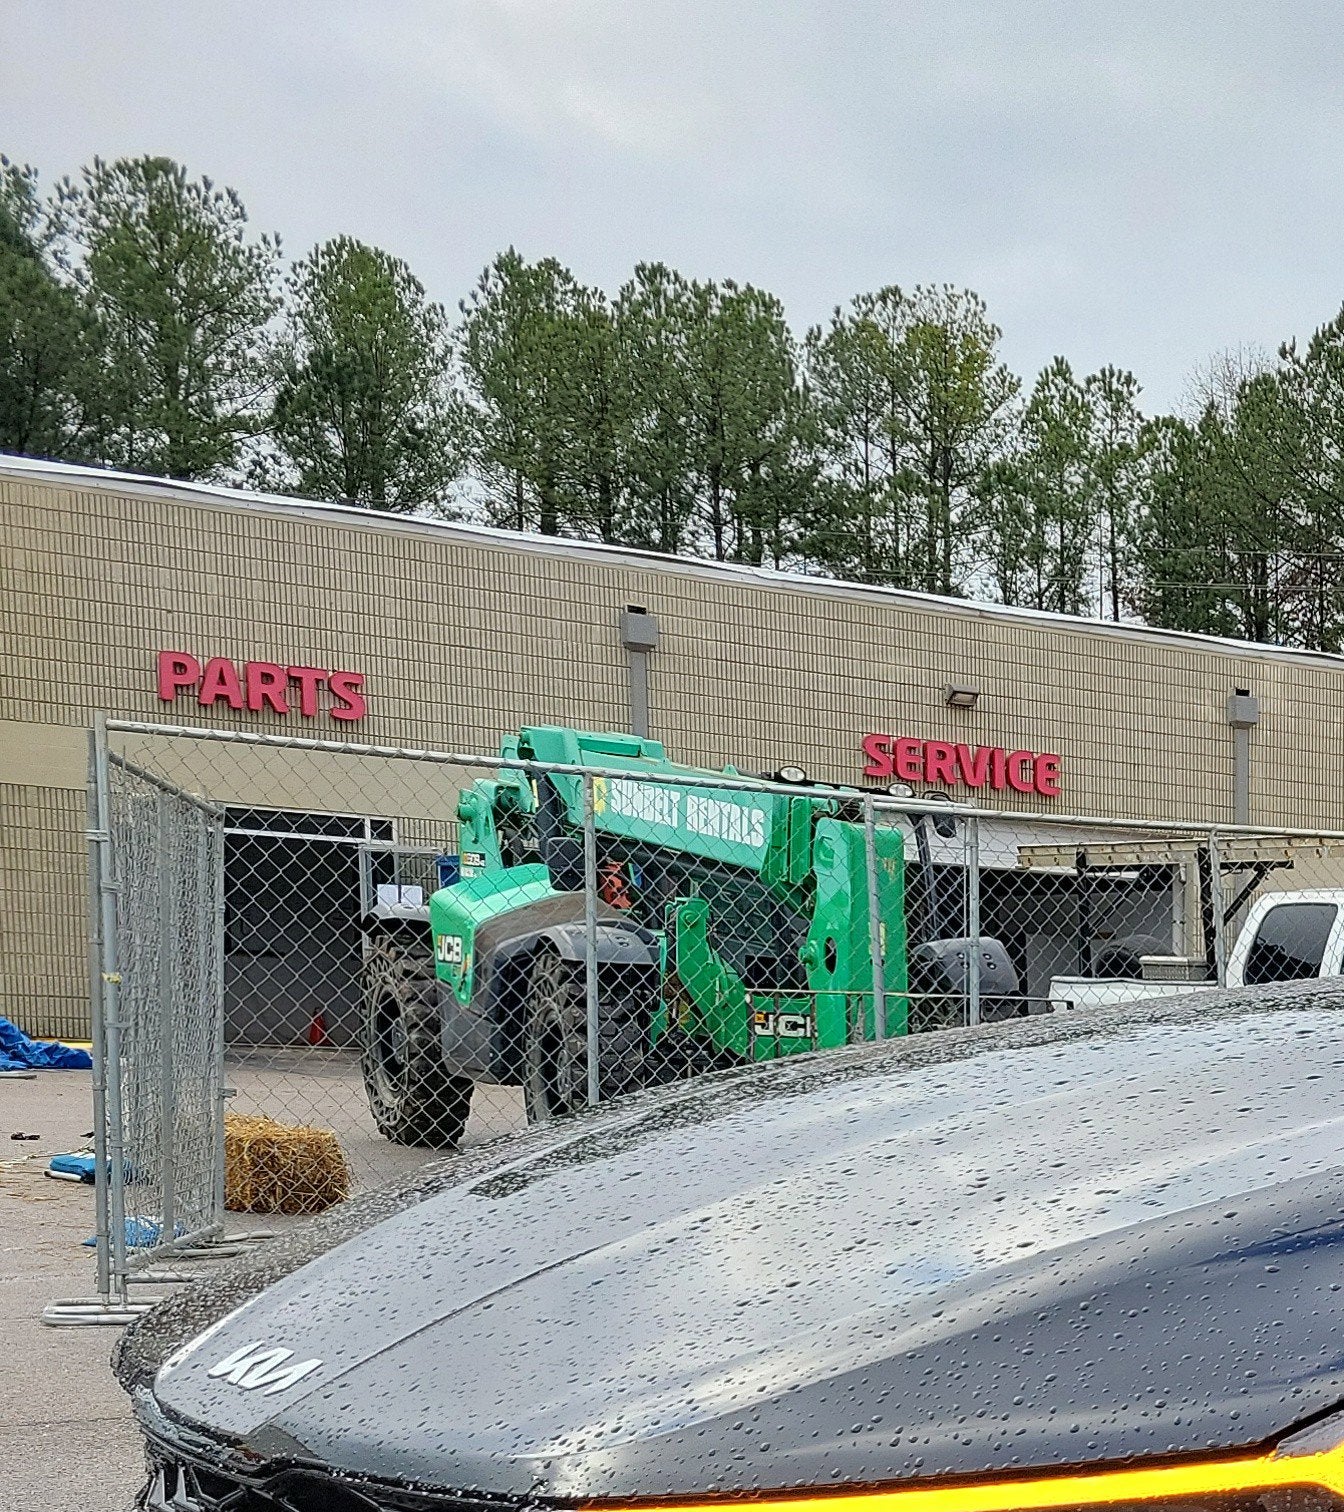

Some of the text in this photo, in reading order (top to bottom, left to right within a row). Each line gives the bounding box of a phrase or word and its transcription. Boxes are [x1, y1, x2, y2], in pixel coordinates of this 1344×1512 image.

[158, 650, 368, 721] PARTS
[862, 733, 1063, 797] SERVICE
[611, 779, 765, 848] SUNBELT RENTALS
[437, 934, 463, 963] JCB
[208, 1341, 324, 1396] KIA
